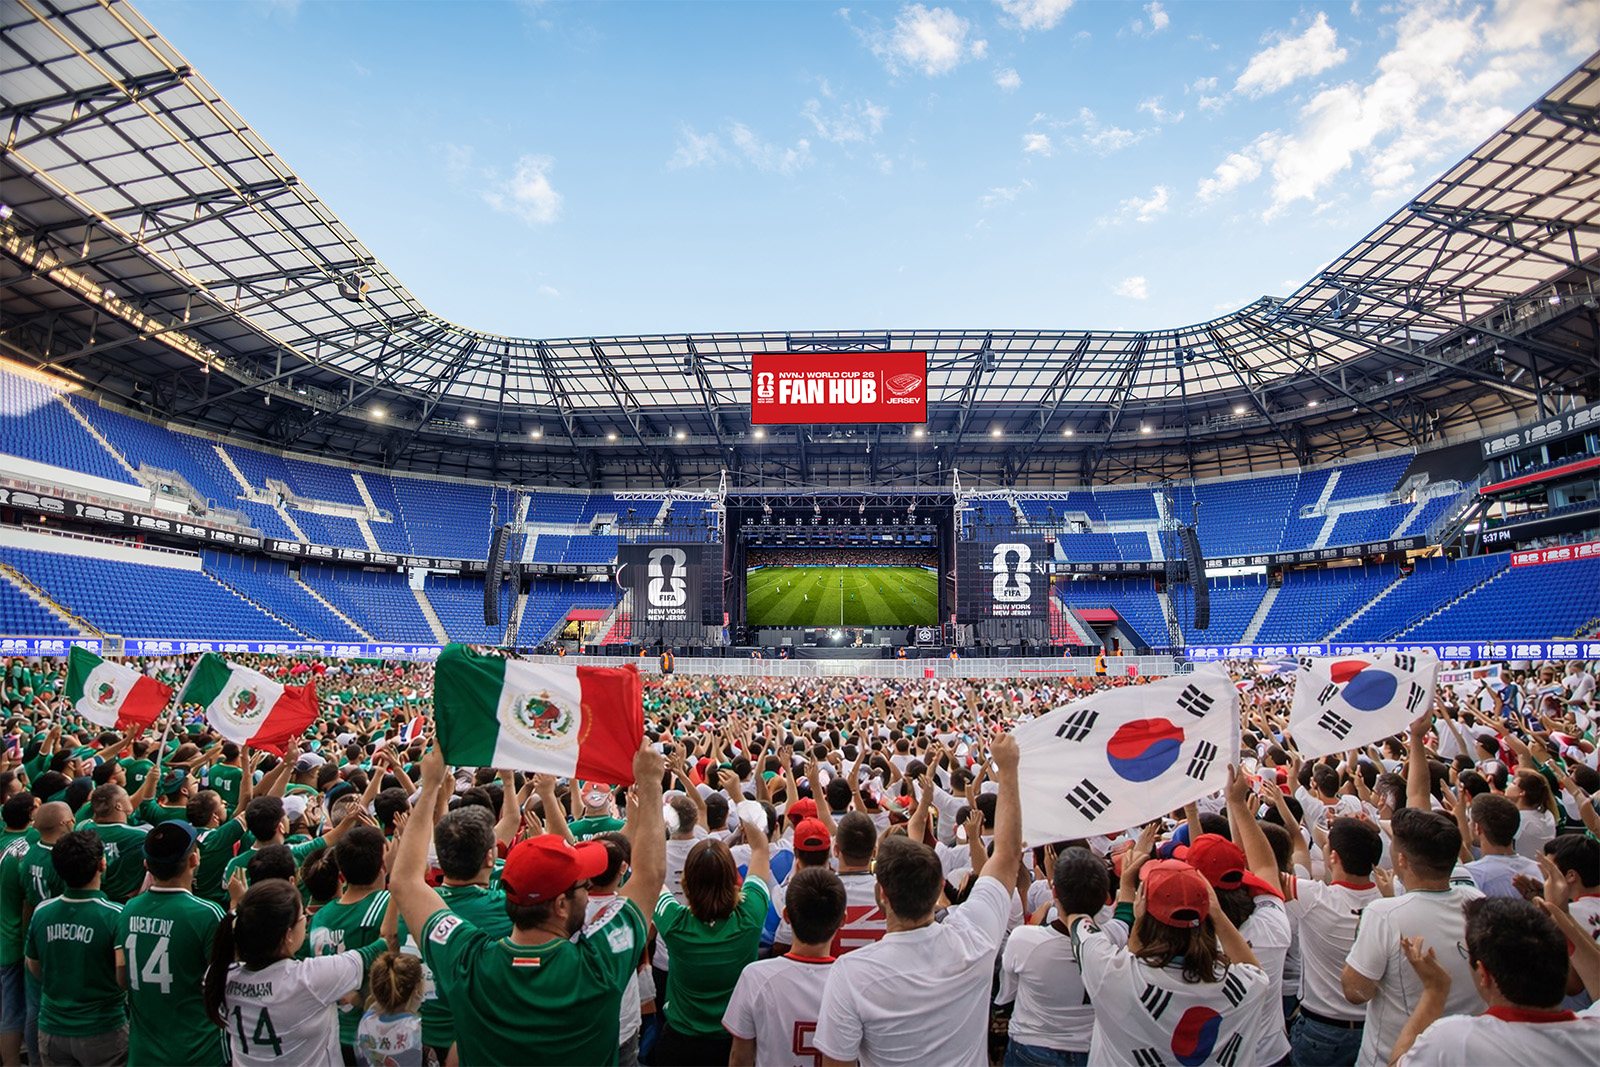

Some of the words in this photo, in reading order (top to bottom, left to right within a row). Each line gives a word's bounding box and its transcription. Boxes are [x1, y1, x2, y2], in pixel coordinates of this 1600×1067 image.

[806, 371, 840, 379] WORLD
[779, 379, 824, 404] FAN
[828, 379, 877, 404] HUB
[1482, 532, 1498, 543] 5:37
[1499, 530, 1510, 540] PM
[125, 933, 173, 994] 14
[231, 1005, 283, 1056] 14
